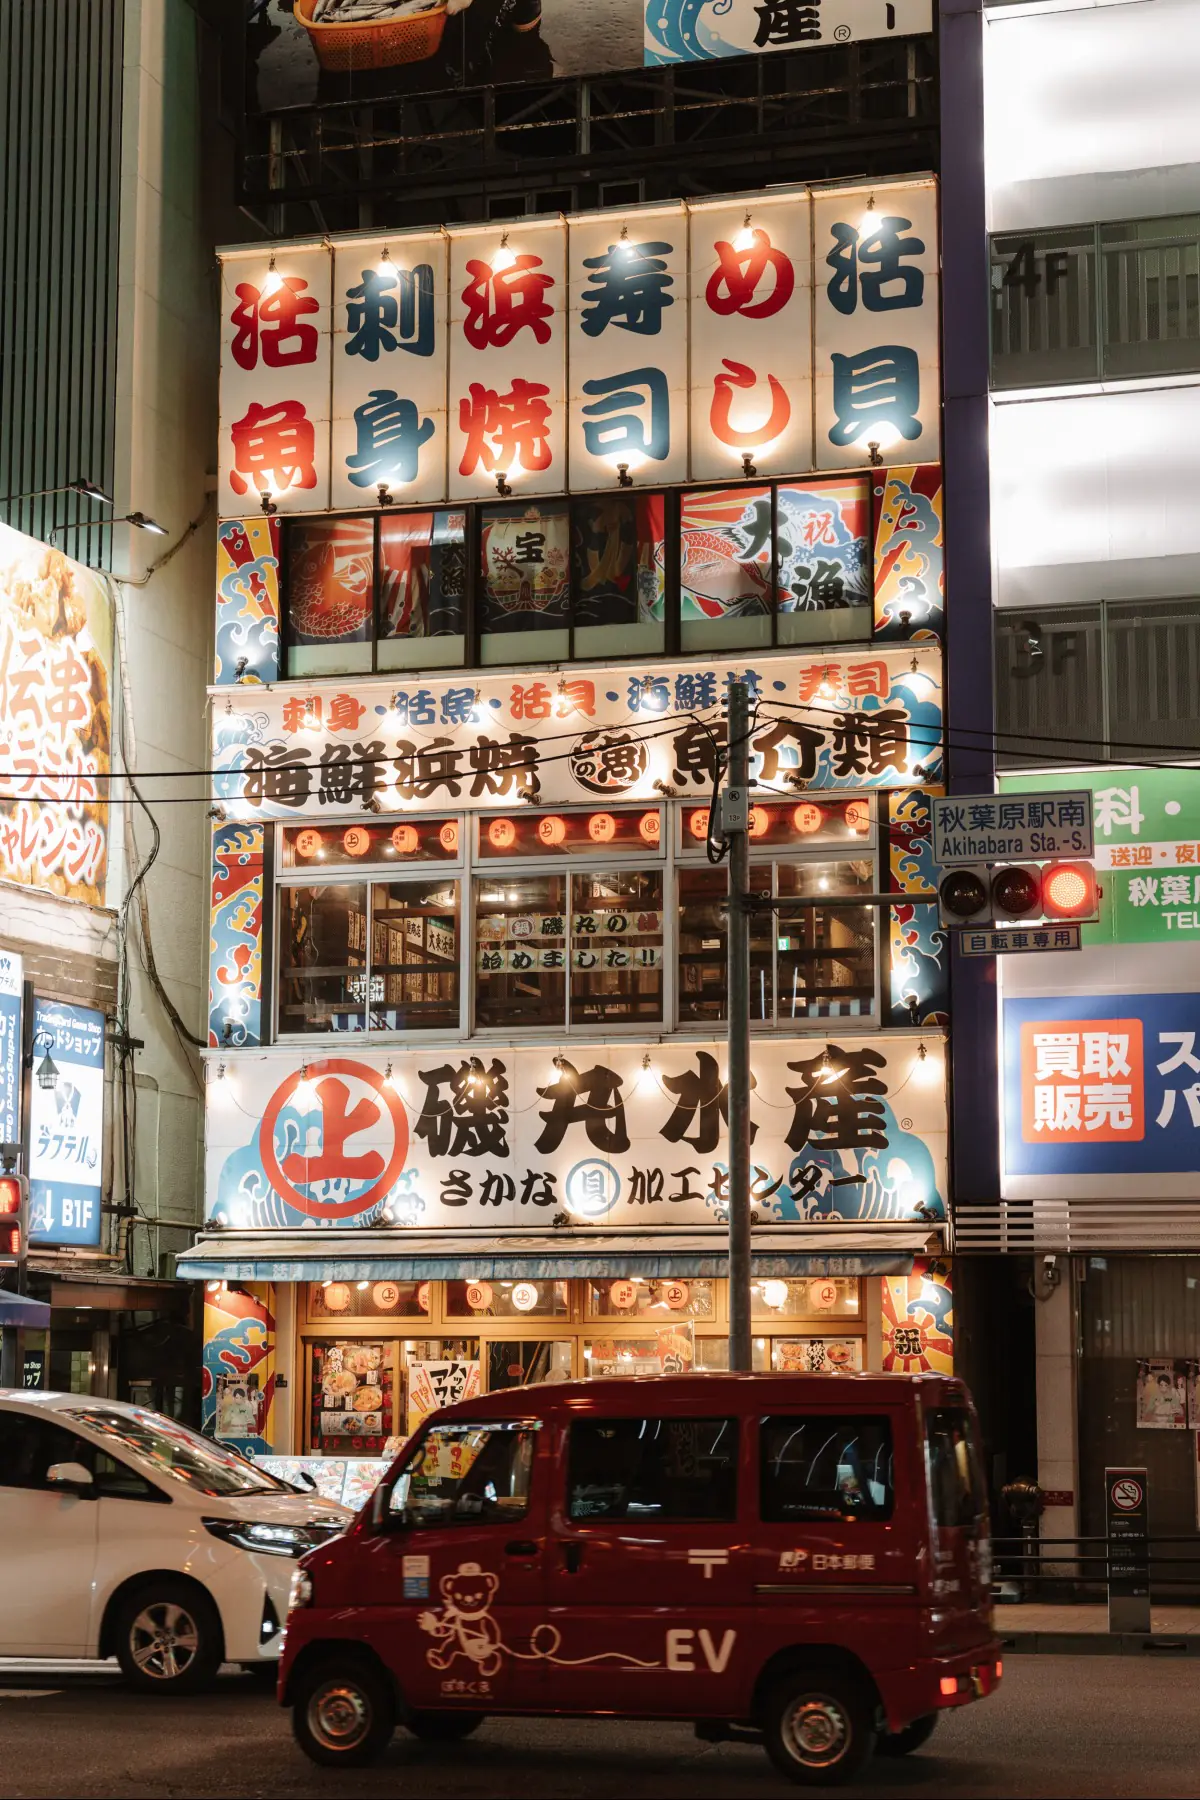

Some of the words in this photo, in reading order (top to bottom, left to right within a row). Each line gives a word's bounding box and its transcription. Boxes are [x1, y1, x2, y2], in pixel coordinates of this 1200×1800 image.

[1003, 242, 1068, 298] 4F
[581, 241, 675, 461] 寿司
[706, 229, 795, 447] めし
[827, 216, 926, 447] 活貝
[231, 276, 319, 494] 活魚
[345, 264, 436, 487] 刺身
[459, 254, 555, 475] 浜焼
[515, 532, 547, 563] 宝
[803, 512, 836, 546] 祝
[243, 733, 540, 808] 海鮮浜焼
[938, 800, 1086, 833] 秋葉原駅南
[941, 836, 1023, 857] Akihabara
[970, 929, 1071, 951] 自転車専用
[36, 1025, 102, 1056] カードショップ
[1033, 1031, 1132, 1081] 買取
[1156, 1031, 1200, 1076] ス
[414, 1044, 889, 1158] 磯丸水産
[1033, 1082, 1133, 1132] 販売
[440, 1165, 557, 1207] さかな
[61, 1198, 94, 1229] B1F
[812, 1554, 875, 1570] 日本郵便
[666, 1628, 736, 1672] EV
